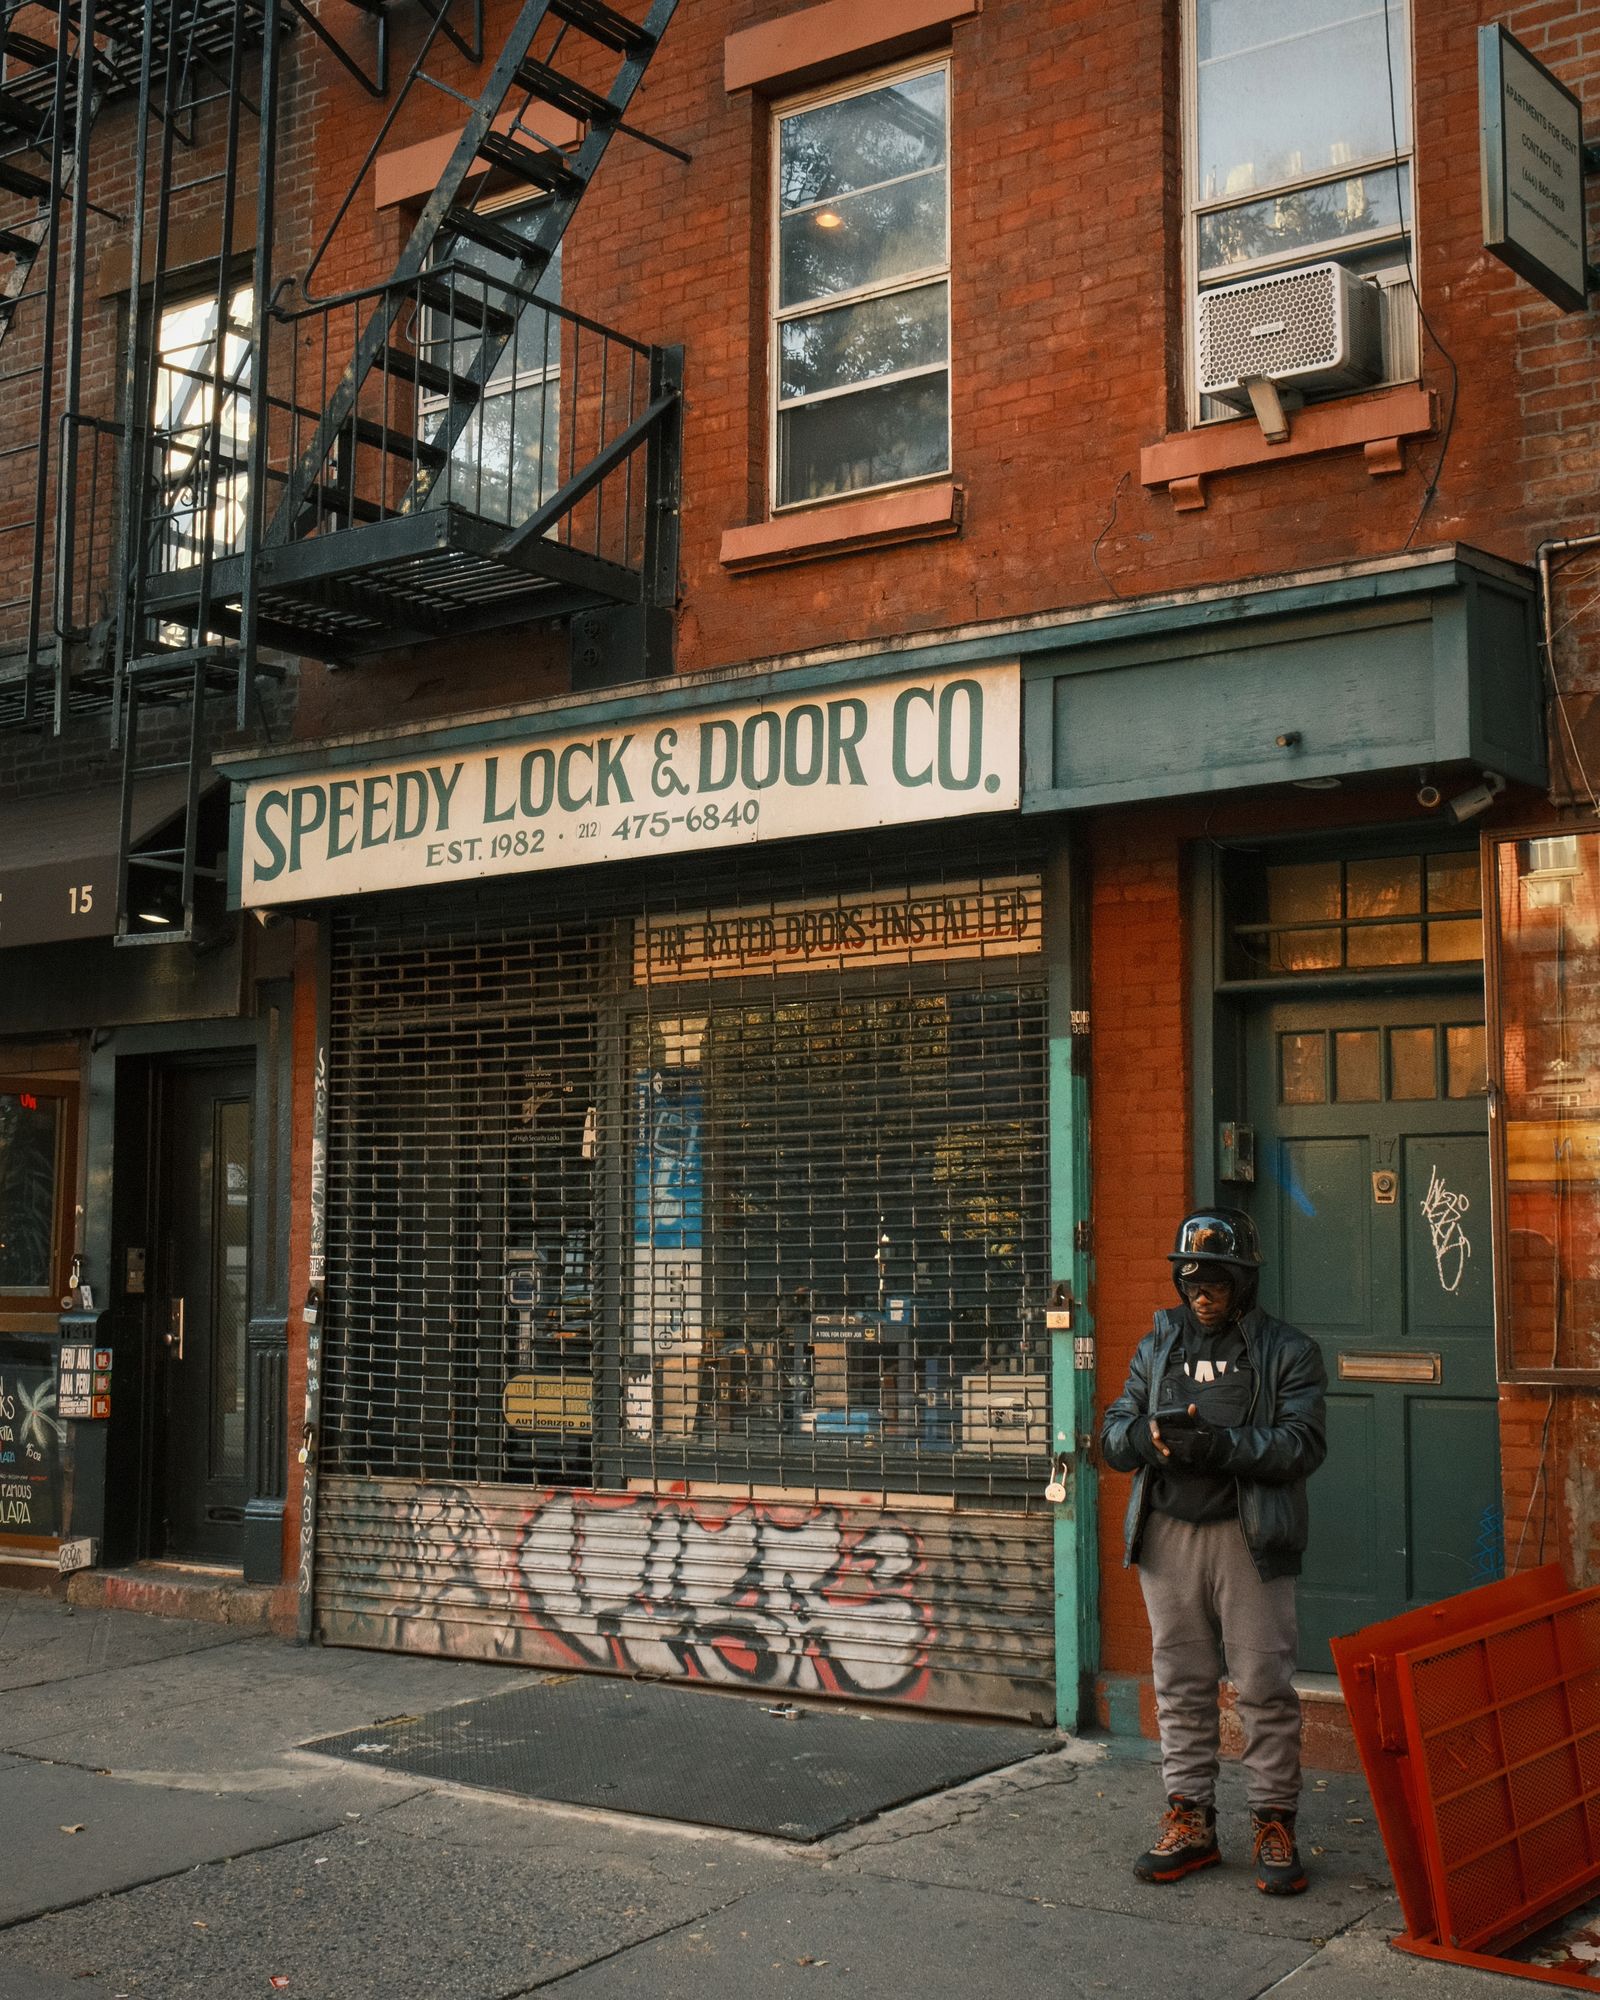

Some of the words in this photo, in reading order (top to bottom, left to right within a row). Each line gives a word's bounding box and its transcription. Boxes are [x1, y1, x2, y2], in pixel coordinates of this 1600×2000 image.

[1506, 83, 1547, 131] APARTMENTS
[1548, 121, 1560, 141] FOR
[1561, 133, 1577, 156] RENT
[1521, 133, 1552, 168] CONTACT
[253, 762, 464, 882] SPEEDY
[483, 734, 635, 824] LOCK
[651, 727, 690, 798] &
[697, 697, 868, 794] DOOR
[892, 678, 1001, 794] CO.
[426, 837, 483, 868] EST.
[491, 828, 545, 859] 1982
[576, 821, 601, 841] (212)
[612, 799, 760, 842] 475-6840
[69, 885, 93, 914] 15
[648, 926, 692, 967] FIRE
[703, 917, 777, 962] RATED
[786, 908, 867, 956] DOORS
[881, 893, 1029, 947] INSTALLED
[529, 1132, 547, 1143] Security
[1376, 1138, 1397, 1164] 17
[61, 1348, 76, 1370] PERU
[76, 1348, 91, 1370] ANA
[60, 1373, 74, 1395] ANA
[75, 1373, 91, 1395] PERU
[1, 1483, 32, 1500] FAMOUS
